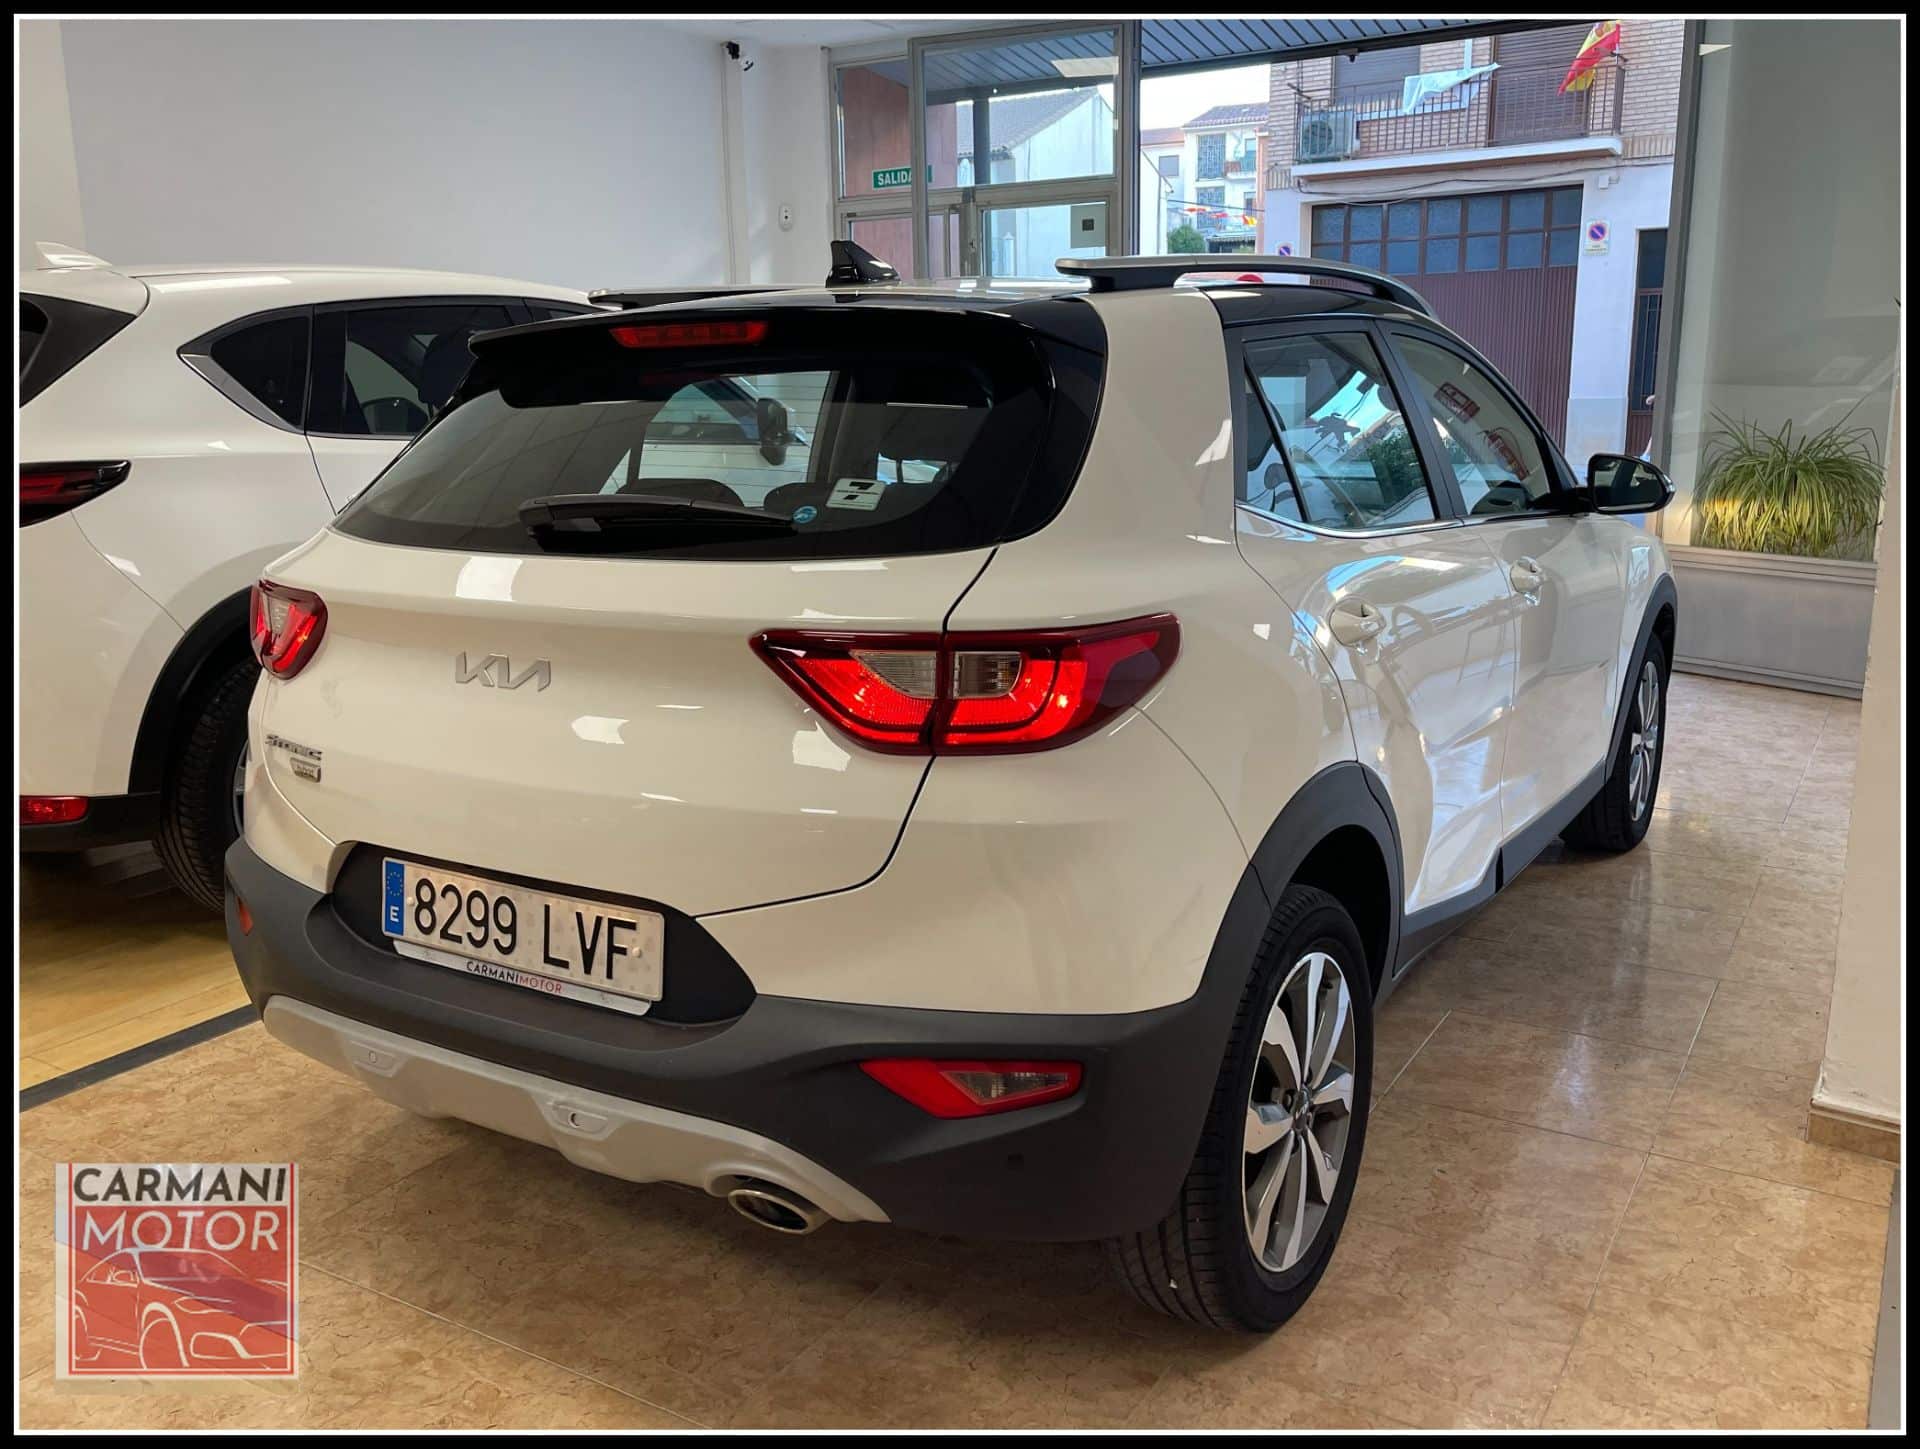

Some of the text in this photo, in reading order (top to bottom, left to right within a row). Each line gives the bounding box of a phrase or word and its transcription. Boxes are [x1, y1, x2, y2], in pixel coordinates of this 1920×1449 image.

[389, 905, 400, 923] E
[414, 877, 637, 979] 8299 LVF
